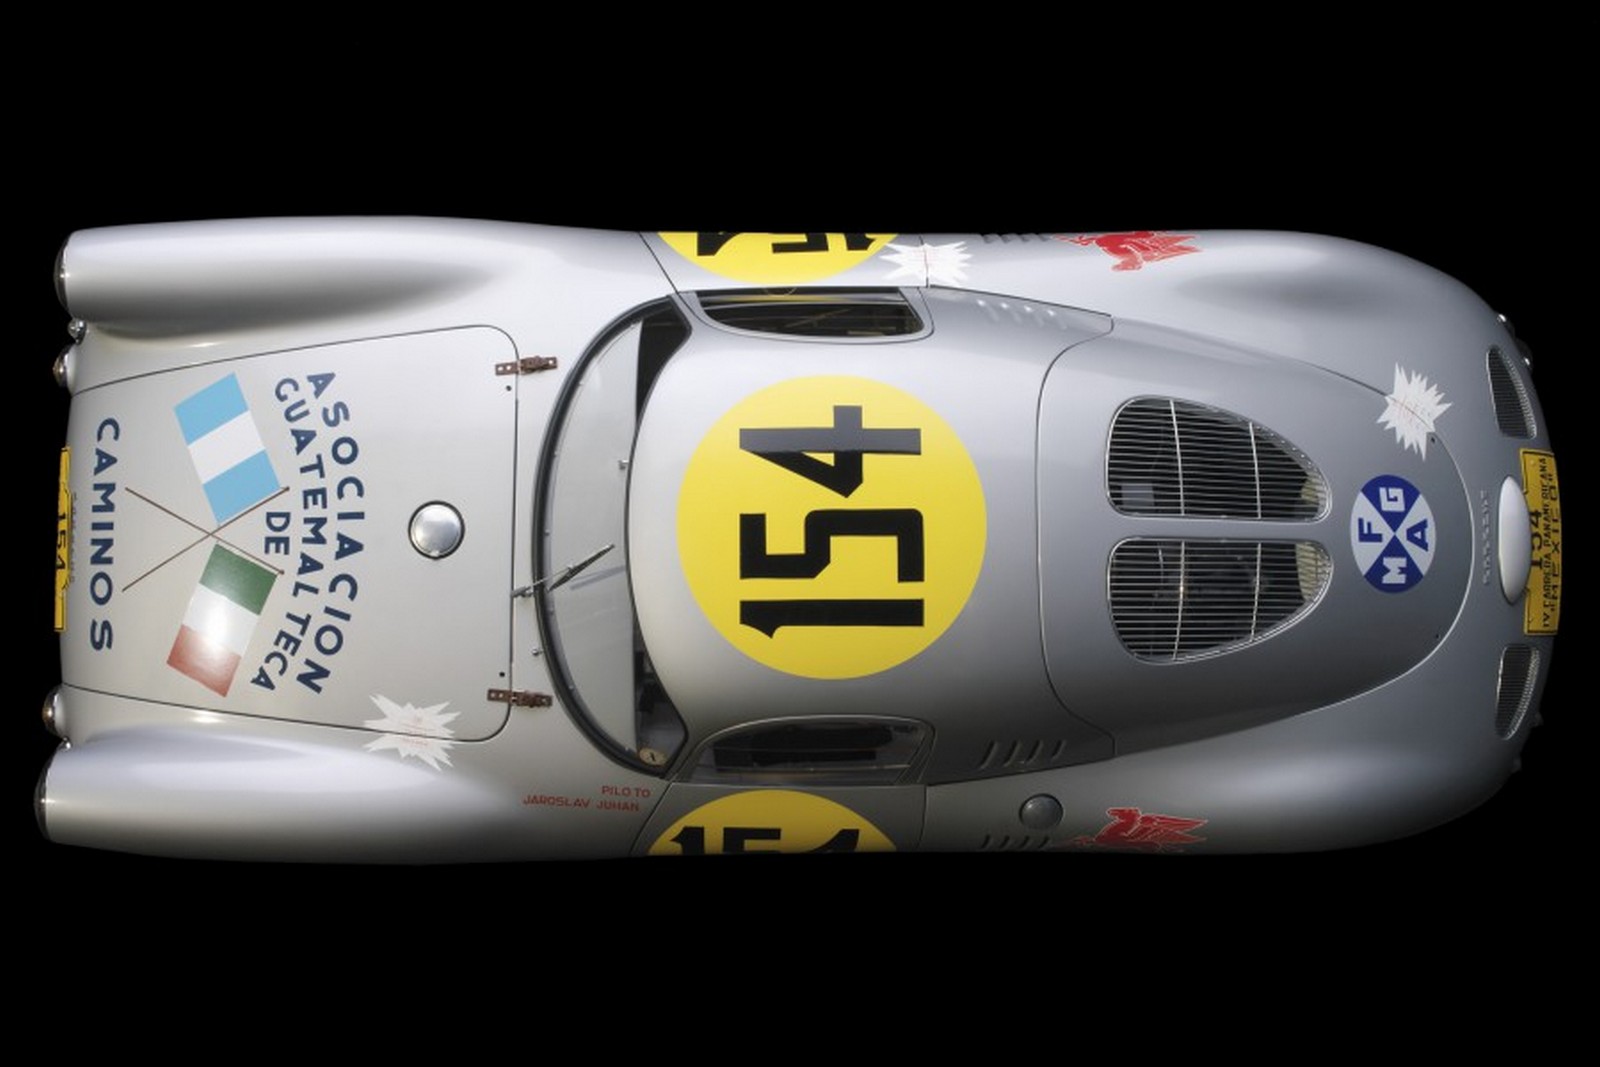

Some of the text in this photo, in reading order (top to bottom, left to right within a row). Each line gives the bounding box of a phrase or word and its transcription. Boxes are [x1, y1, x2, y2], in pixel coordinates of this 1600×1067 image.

[89, 417, 120, 652] CAMINOS
[264, 511, 291, 555] DE
[295, 371, 365, 695] ASOCIACION
[738, 405, 925, 639] 154
[522, 794, 640, 812] JAROSLAV JUHAN
